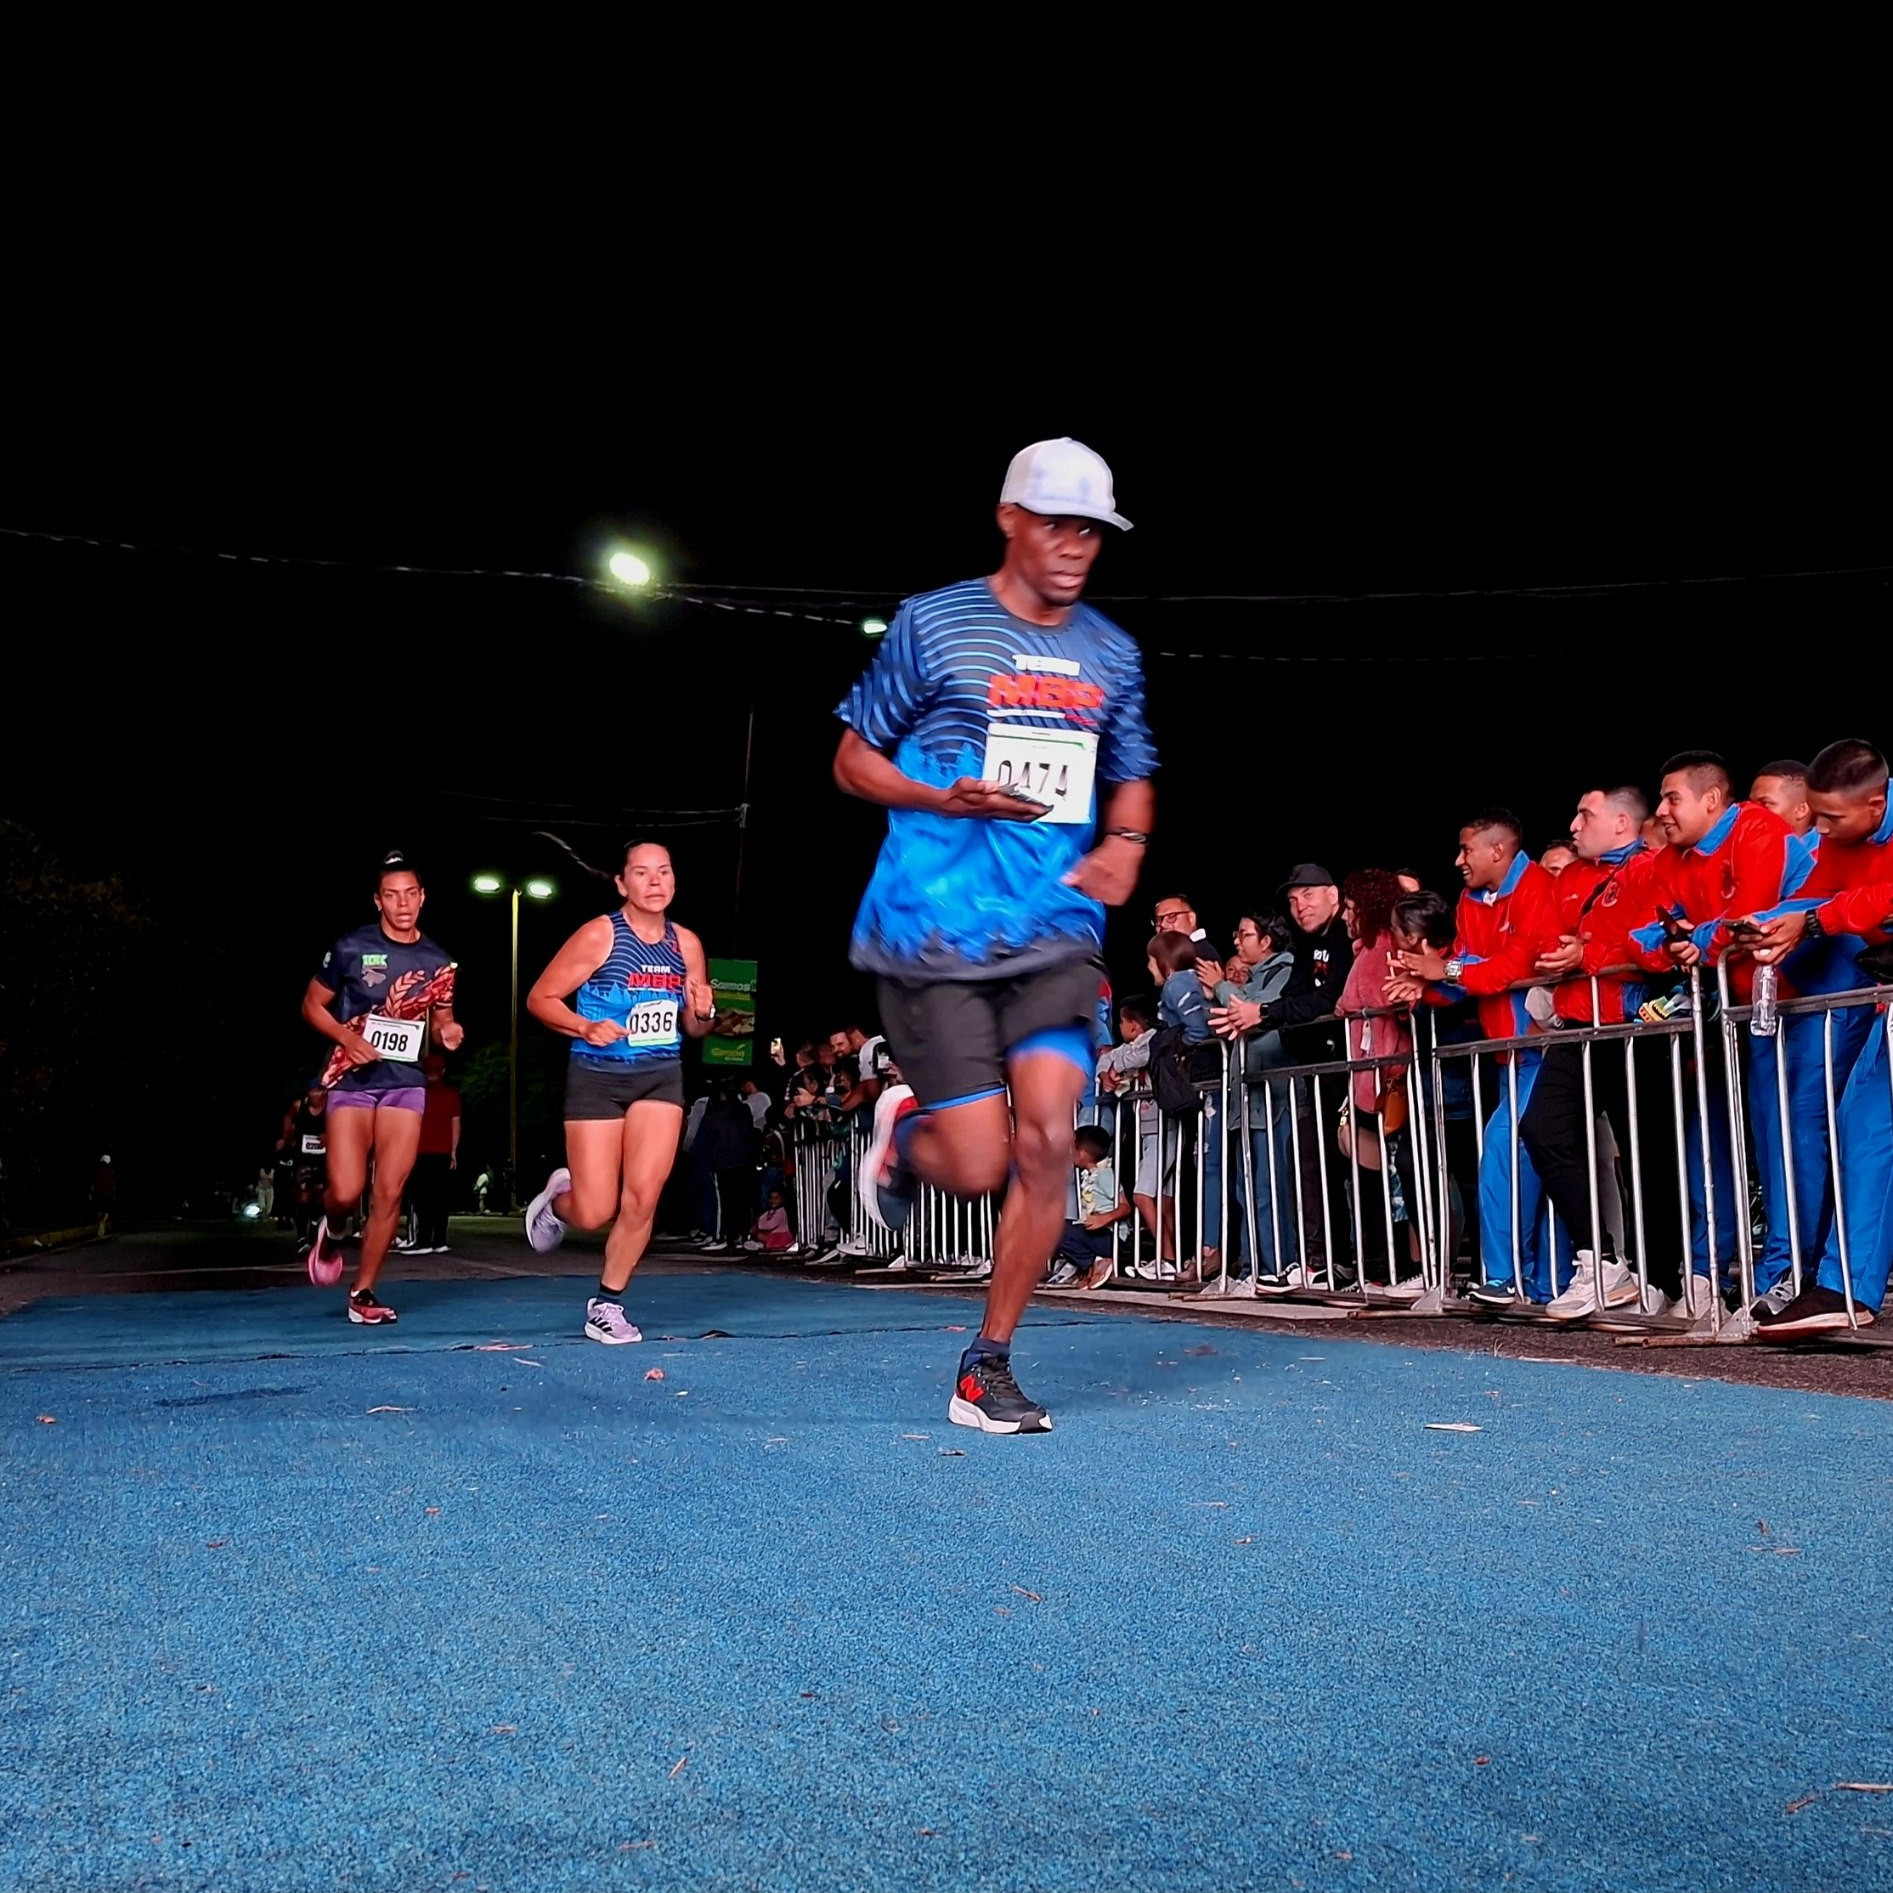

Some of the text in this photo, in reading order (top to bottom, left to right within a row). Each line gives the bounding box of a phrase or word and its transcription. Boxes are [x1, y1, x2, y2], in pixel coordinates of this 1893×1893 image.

[641, 964, 671, 974] TEAM
[629, 1011, 674, 1035] 0336
[370, 1030, 409, 1052] 0198
